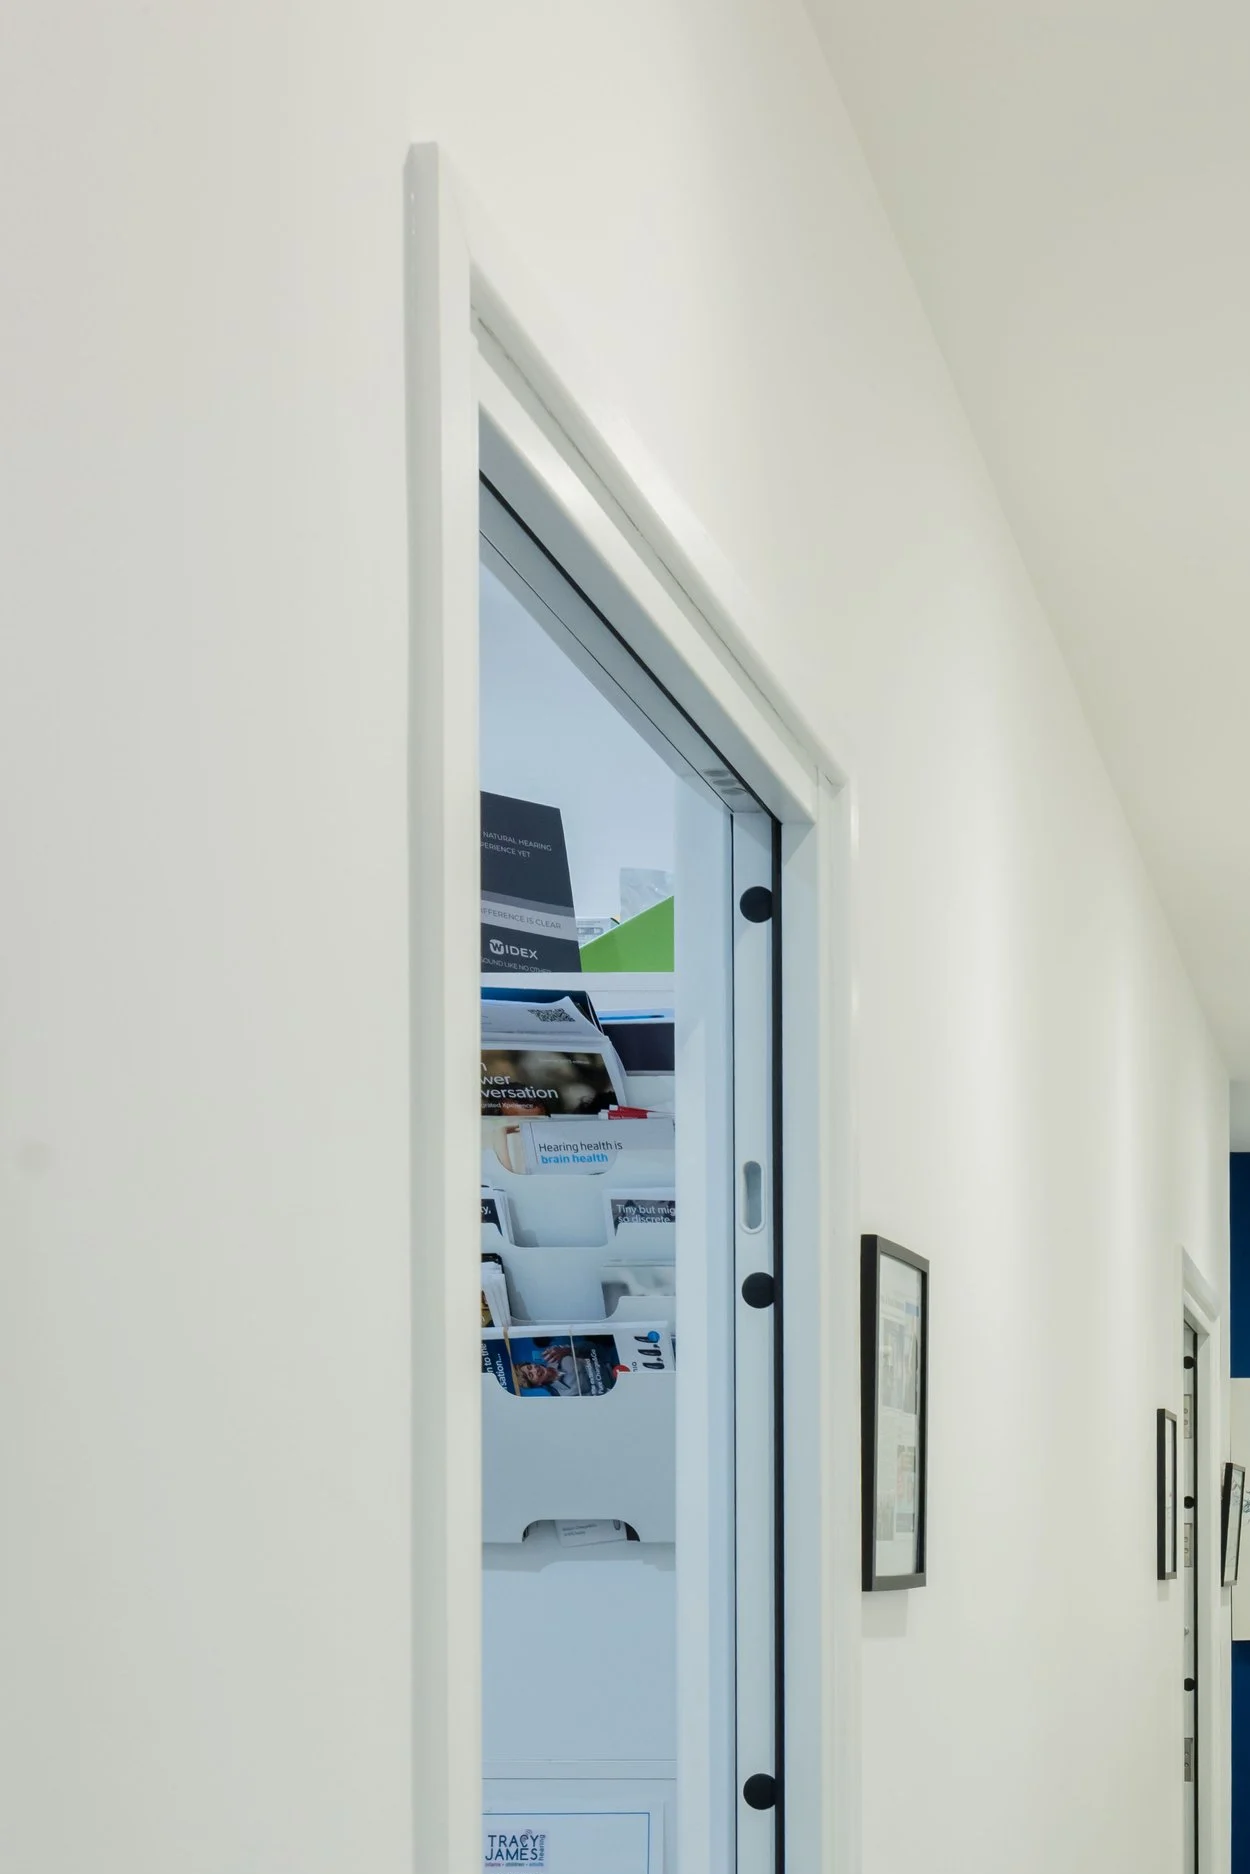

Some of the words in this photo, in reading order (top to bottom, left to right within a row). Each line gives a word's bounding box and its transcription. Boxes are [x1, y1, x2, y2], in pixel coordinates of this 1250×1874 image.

[482, 831, 517, 845] NATURAL
[518, 839, 552, 852] HEARING
[517, 850, 531, 858] YET
[526, 916, 534, 925] IS
[535, 918, 562, 929] CLEAR
[489, 938, 538, 960] WIDEX
[504, 959, 518, 970] LIKE
[518, 962, 530, 972] NO
[539, 1143, 579, 1154] Hearing
[580, 1141, 613, 1151] health
[614, 1141, 623, 1150] is
[541, 1154, 570, 1164] brain
[572, 1153, 609, 1163] health
[616, 1204, 637, 1216] Tiny
[638, 1205, 656, 1214] but
[631, 1214, 671, 1223] discrete
[488, 1834, 539, 1848] TRACY
[485, 1847, 538, 1861] JAMES
